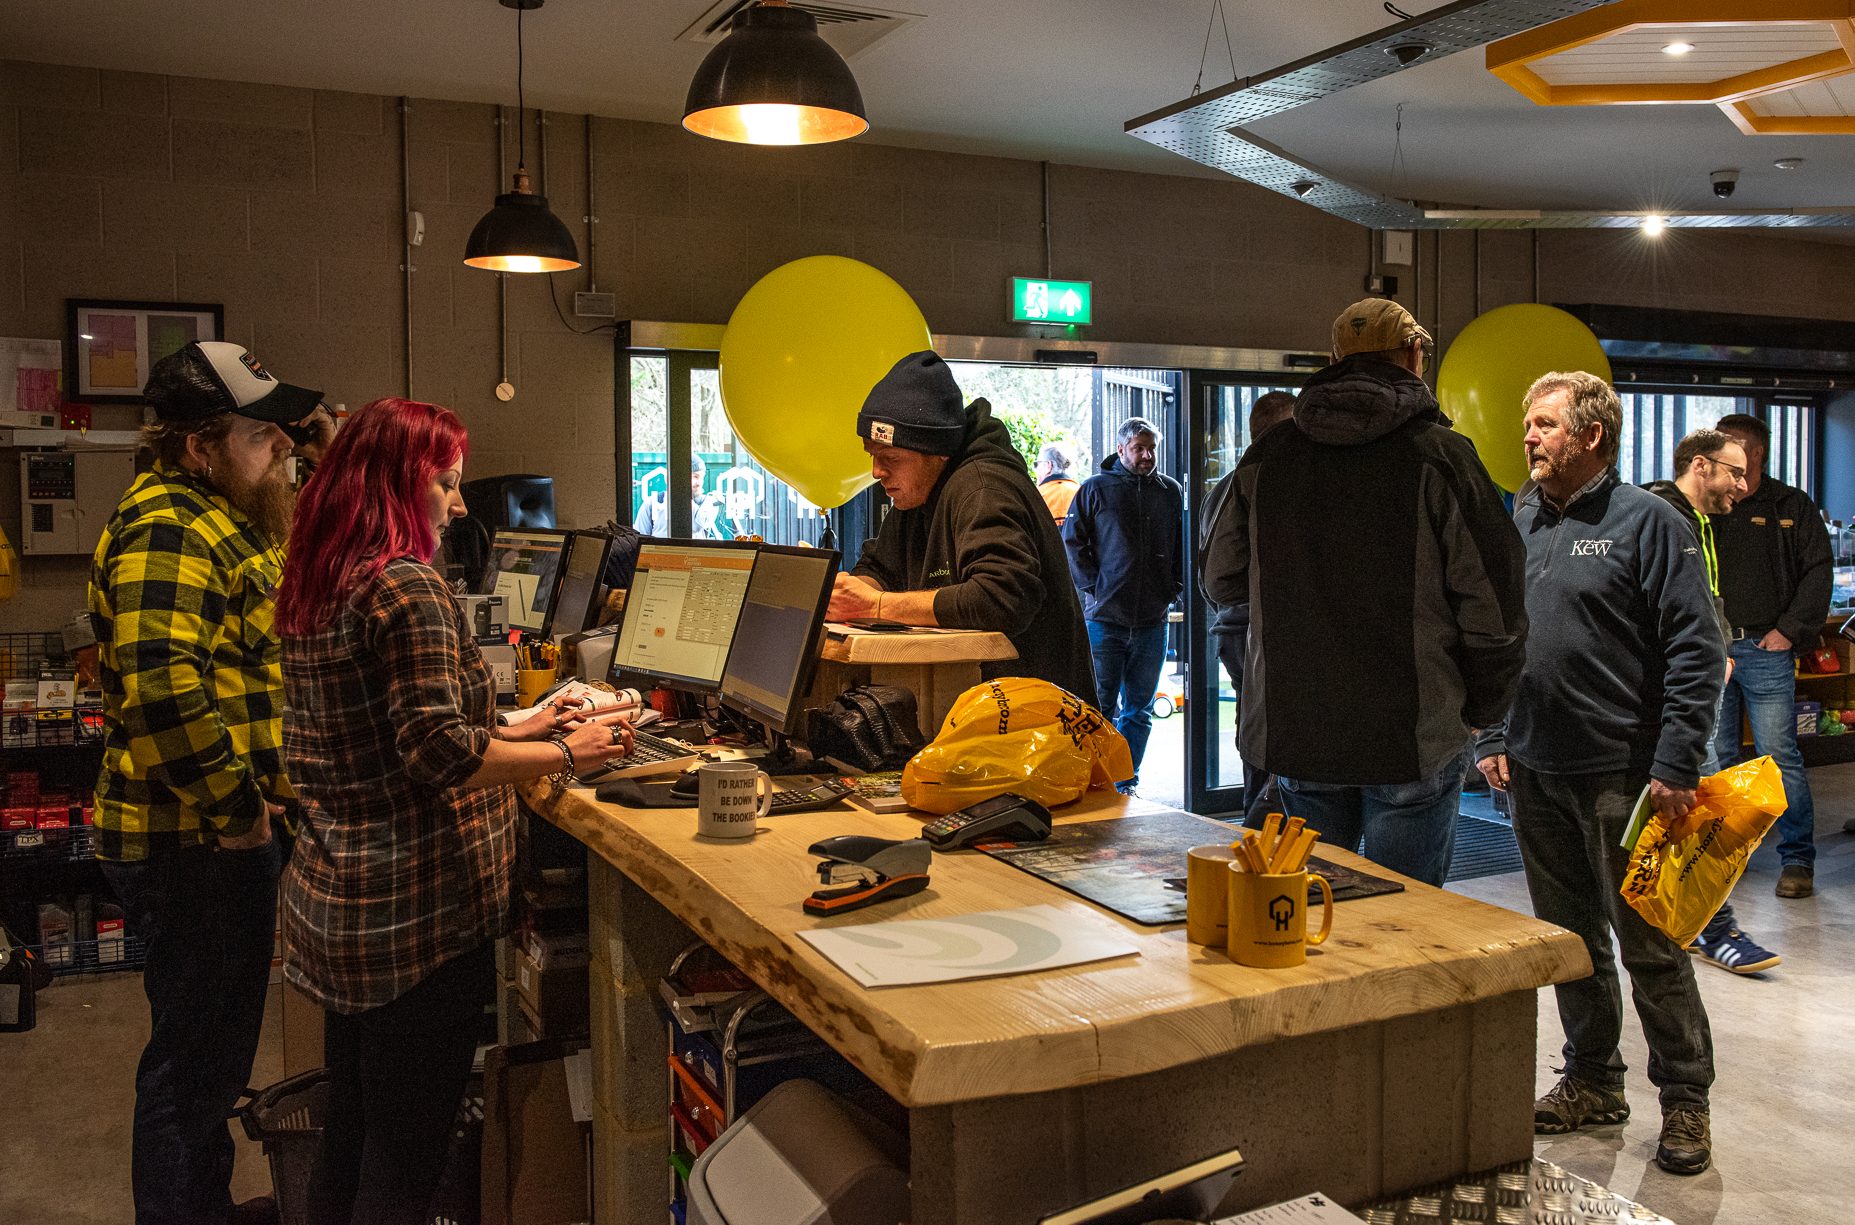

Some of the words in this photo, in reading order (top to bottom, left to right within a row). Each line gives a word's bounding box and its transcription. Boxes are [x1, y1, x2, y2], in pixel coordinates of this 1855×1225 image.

[1569, 540, 1612, 557] Kew
[718, 779, 728, 789] I'D
[729, 778, 755, 789] RATHER
[720, 796, 731, 806] BE
[733, 795, 752, 806] DOWN
[712, 812, 728, 823] THE
